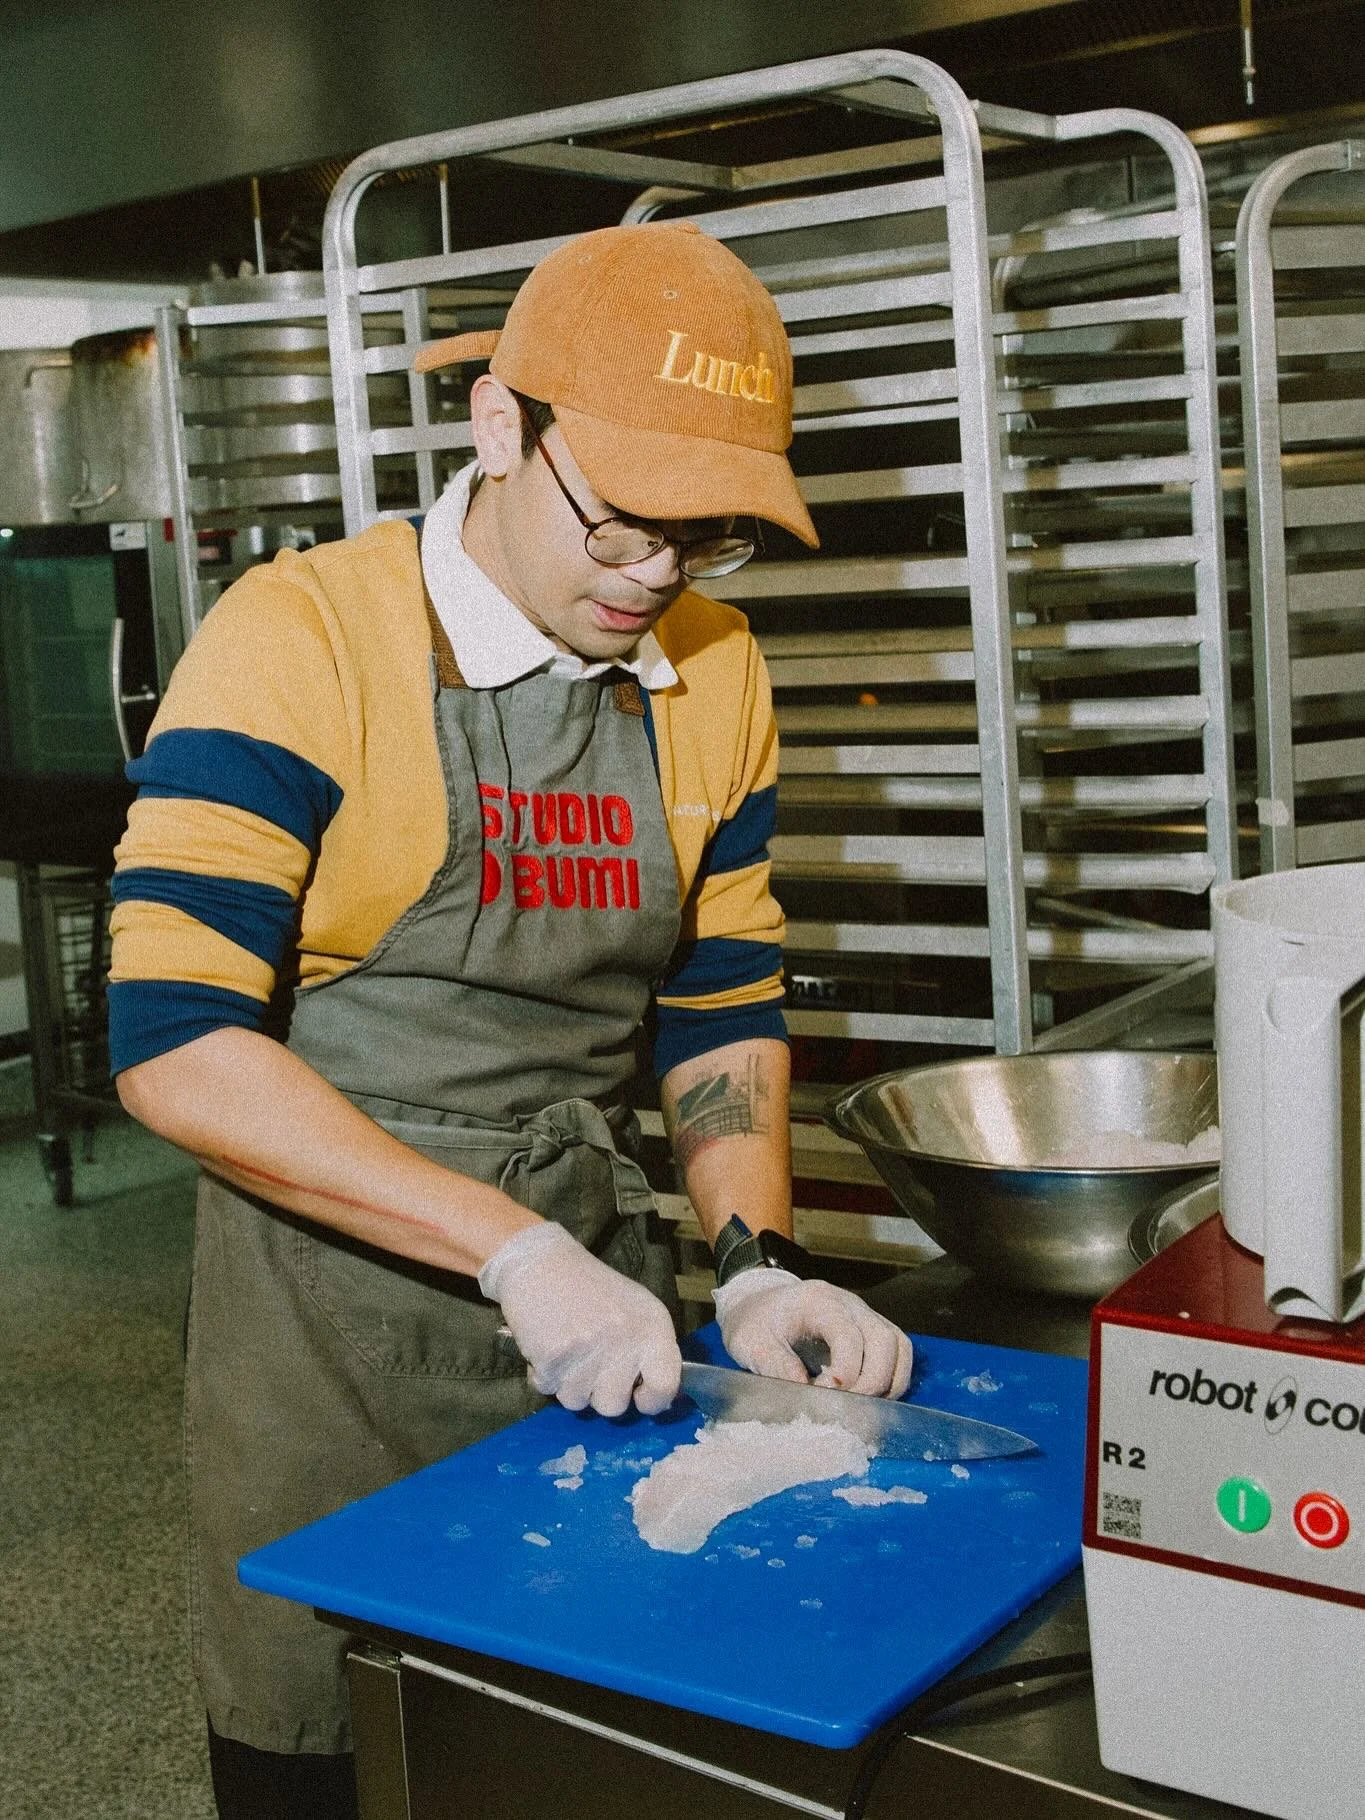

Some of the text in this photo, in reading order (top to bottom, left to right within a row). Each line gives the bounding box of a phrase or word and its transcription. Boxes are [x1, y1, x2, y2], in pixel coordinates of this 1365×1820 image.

[653, 329, 775, 403] Lunch
[478, 783, 634, 847] STUDIO
[1149, 1368, 1365, 1436] robot co
